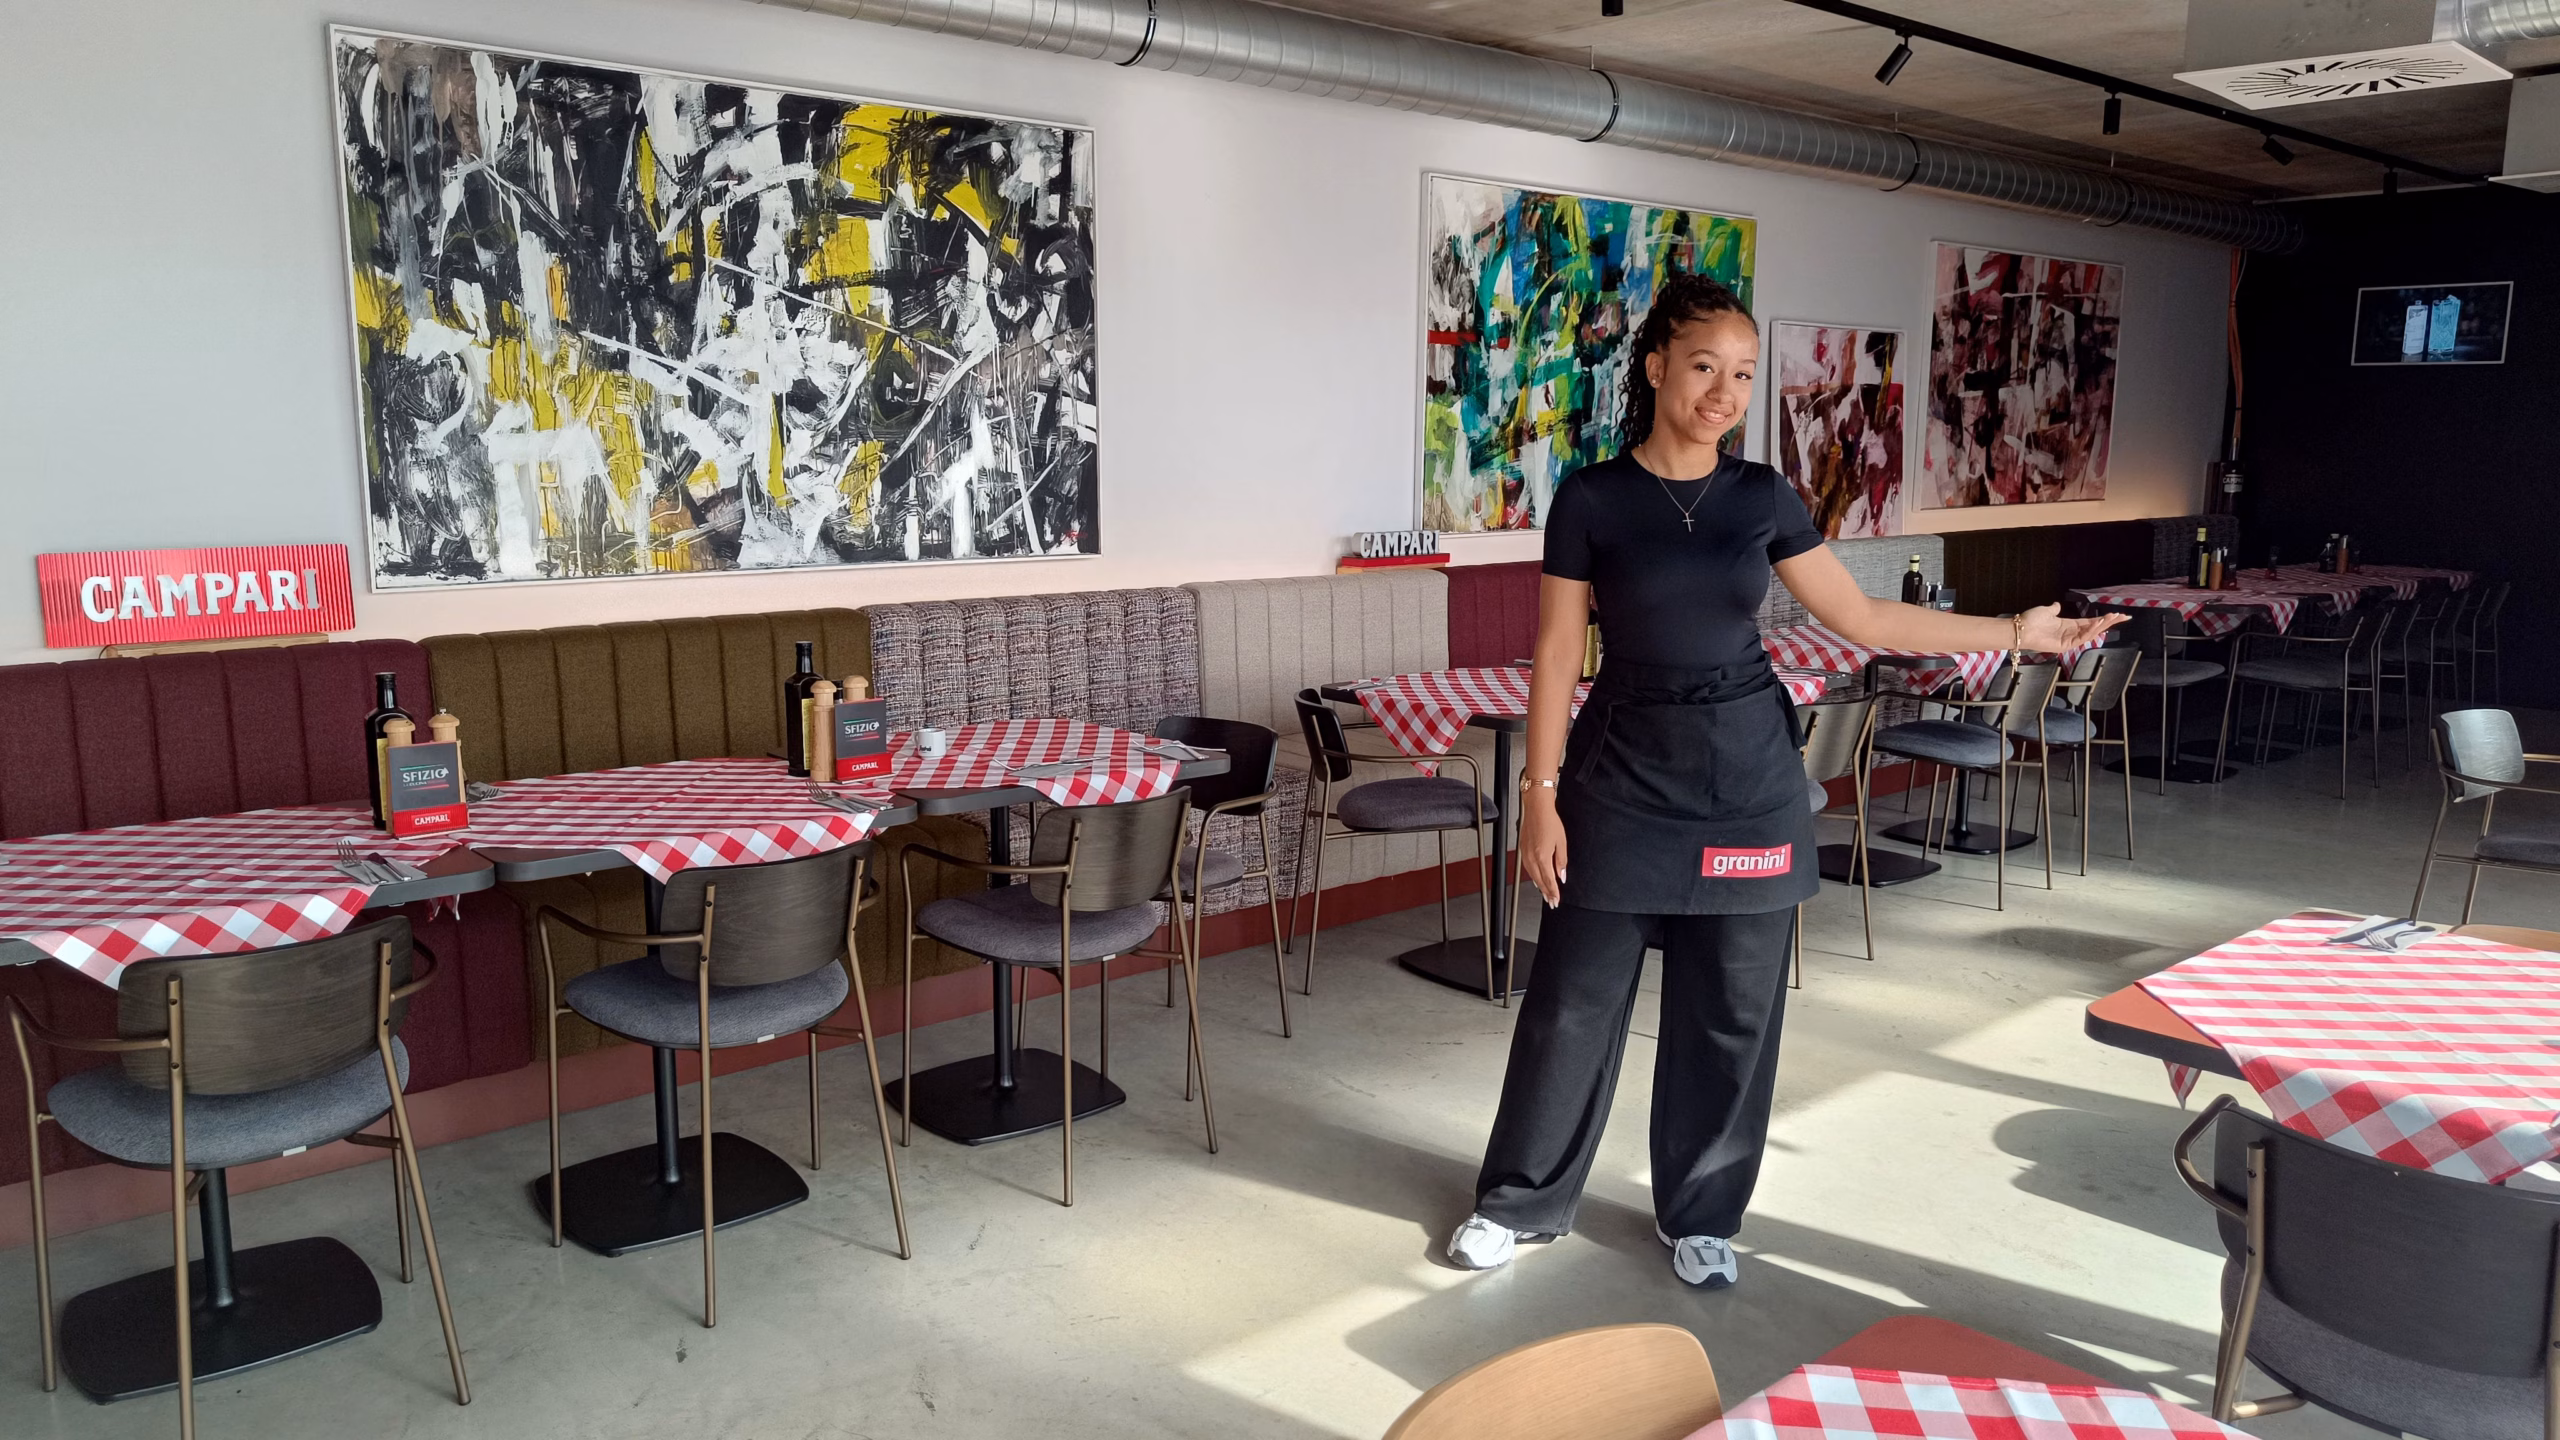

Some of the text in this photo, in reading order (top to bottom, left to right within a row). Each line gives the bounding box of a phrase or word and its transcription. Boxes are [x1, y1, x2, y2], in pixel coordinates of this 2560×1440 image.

[1360, 530, 1440, 558] CAMPARI
[81, 568, 321, 623] CAMPARI
[845, 722, 879, 734] SFIZIO
[852, 762, 878, 771] CAMPARI
[403, 768, 449, 783] SFIZIO
[414, 814, 449, 825] CAMPARI
[1713, 848, 1786, 874] granini
